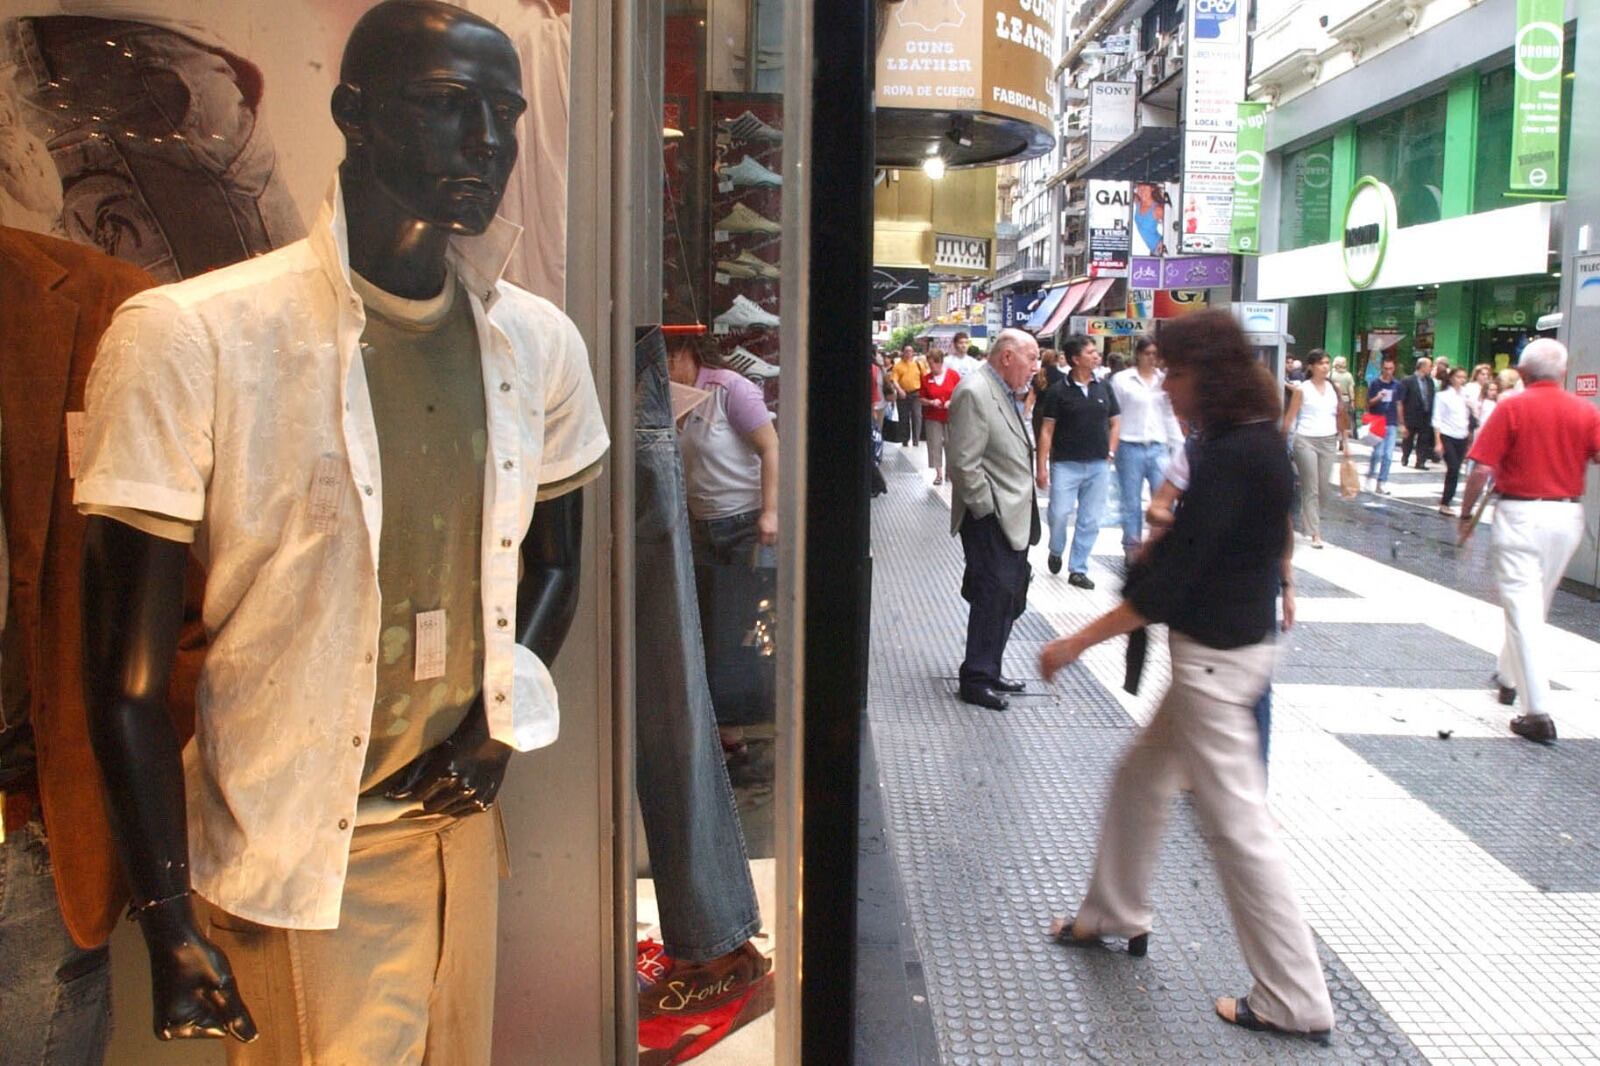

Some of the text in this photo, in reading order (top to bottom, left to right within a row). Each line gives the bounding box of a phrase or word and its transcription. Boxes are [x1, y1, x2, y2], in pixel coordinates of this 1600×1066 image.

[906, 41, 954, 53] GUNS
[887, 58, 972, 72] LEATHER
[883, 85, 975, 97] ROPA DE CUERO
[1096, 86, 1131, 96] SONY
[993, 86, 1037, 112] FABRICA
[1092, 320, 1143, 331] GENOA
